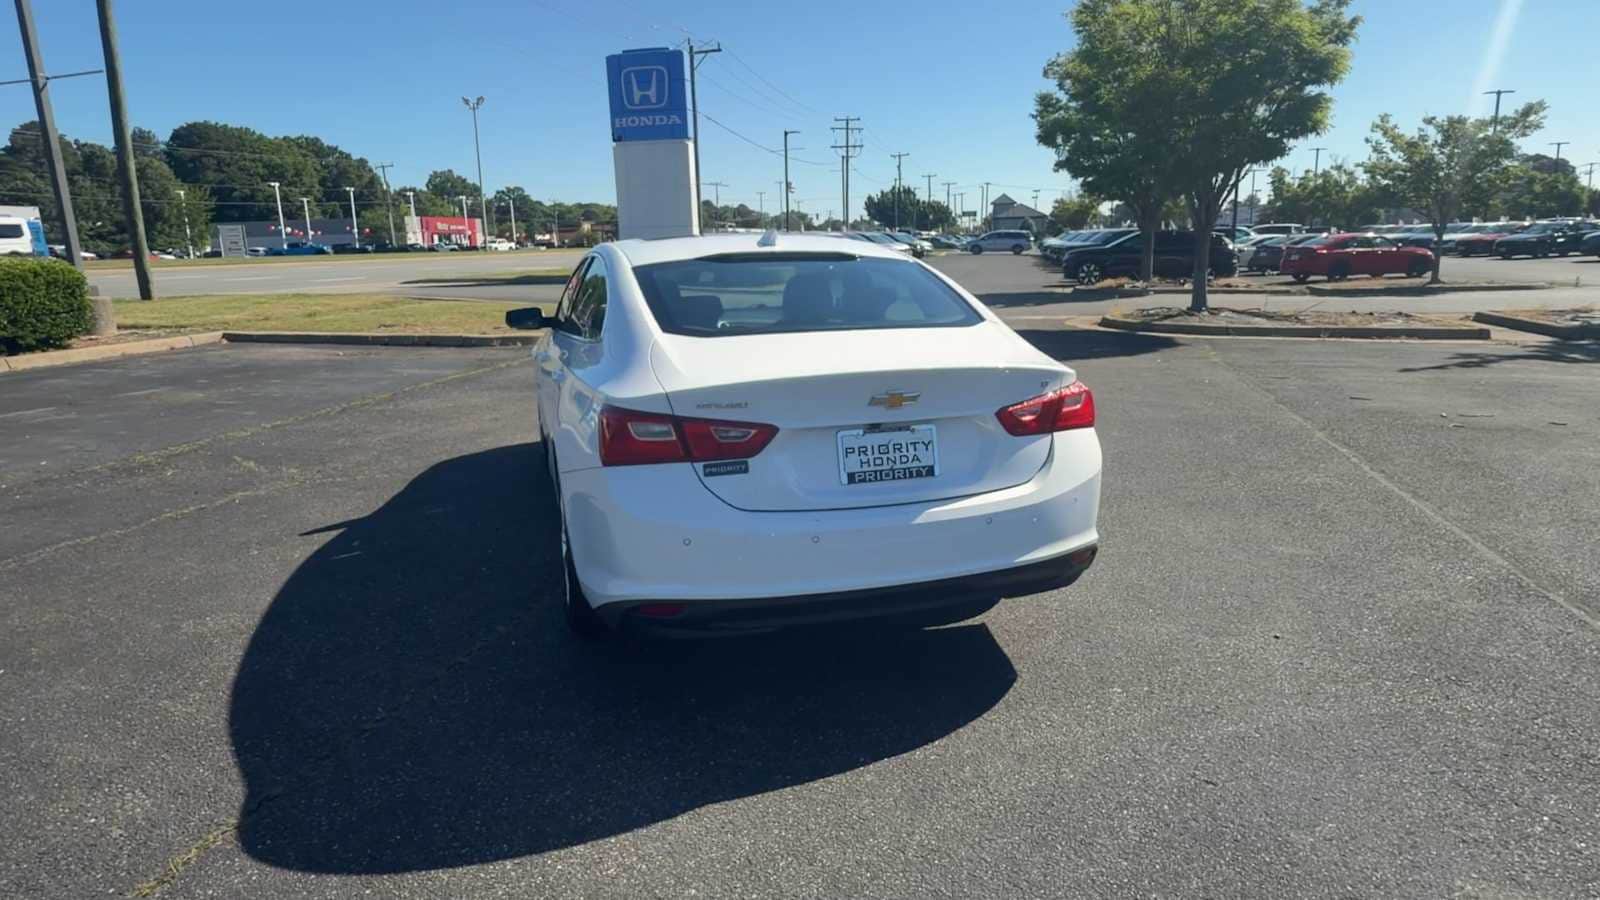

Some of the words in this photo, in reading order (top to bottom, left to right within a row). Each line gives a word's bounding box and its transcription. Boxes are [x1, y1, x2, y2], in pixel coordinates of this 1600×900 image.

[615, 114, 682, 128] HONDA
[845, 439, 932, 459] PRIORITY
[704, 463, 746, 473] PRIORITY
[859, 454, 922, 469] HONDA
[855, 466, 929, 483] PRIORITY
